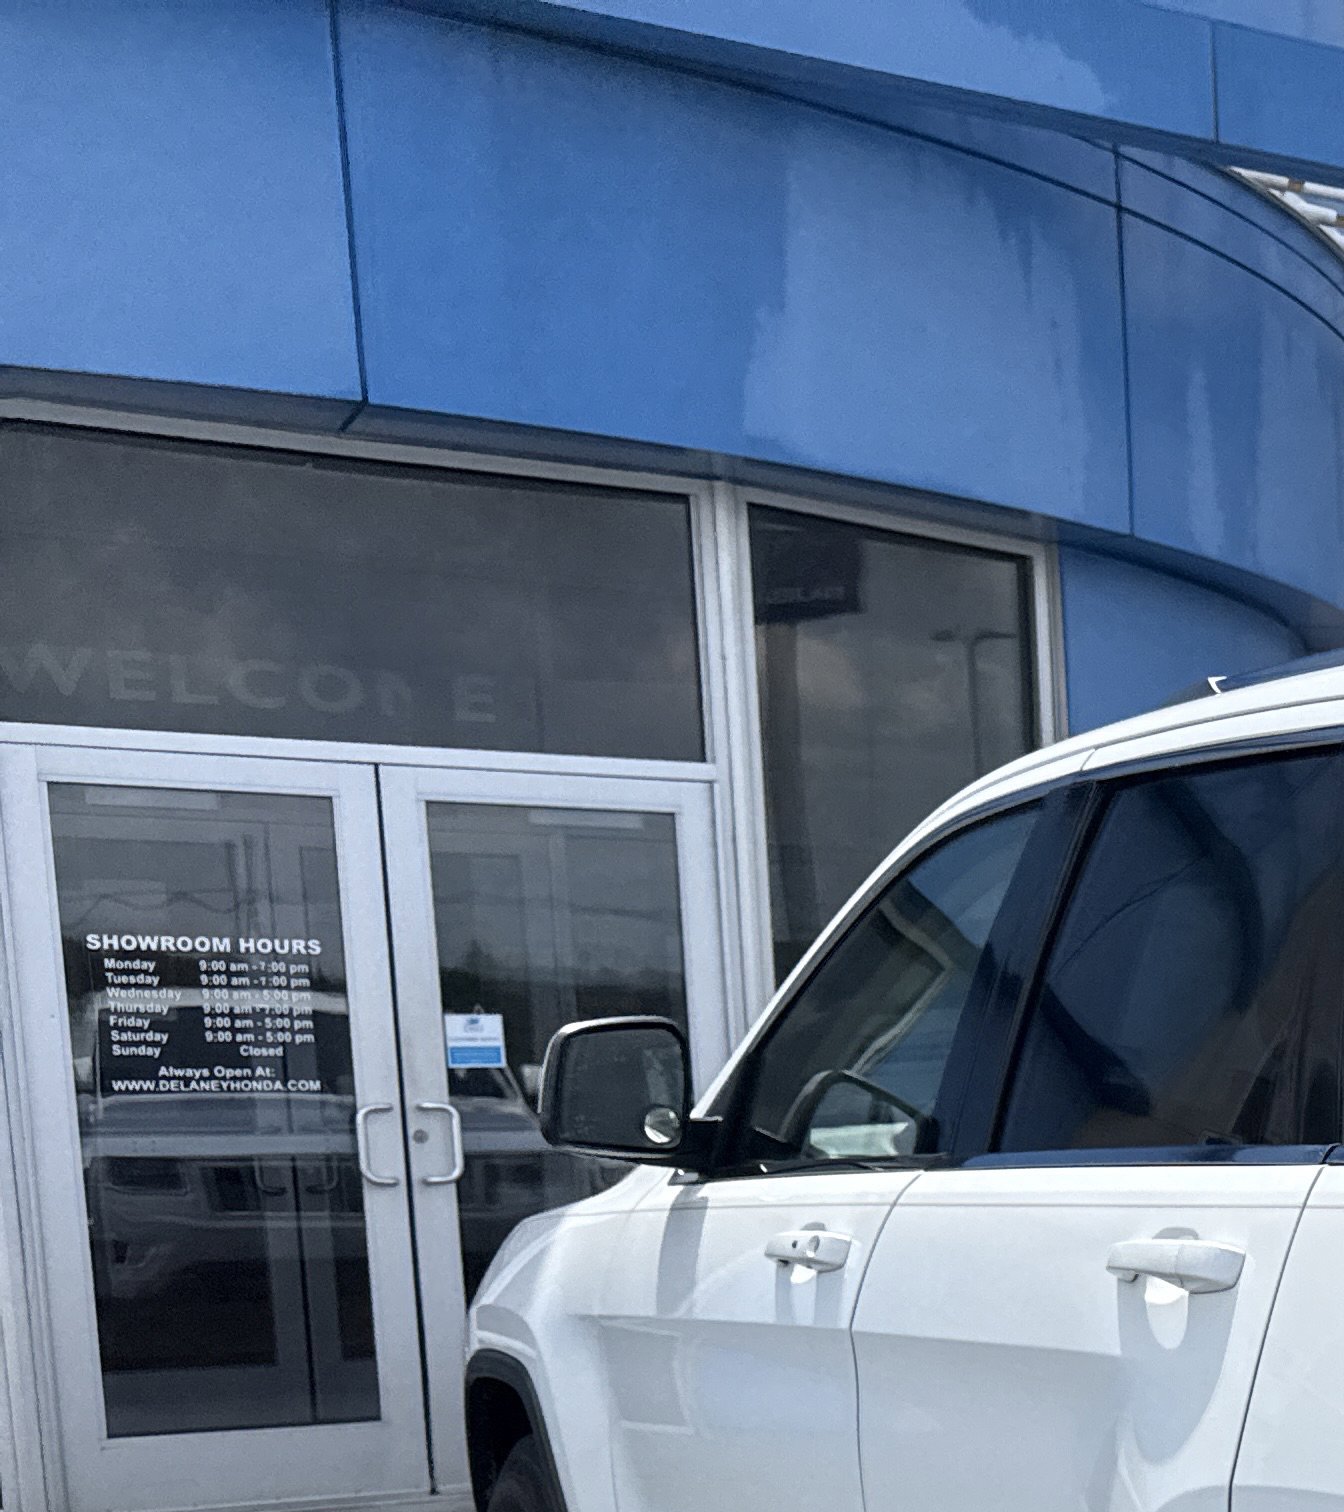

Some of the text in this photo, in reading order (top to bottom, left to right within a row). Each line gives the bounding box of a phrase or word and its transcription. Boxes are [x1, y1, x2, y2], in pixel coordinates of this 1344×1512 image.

[86, 933, 322, 955] SHOWROOM HOURS
[104, 958, 156, 973] Monday
[199, 960, 226, 972] 9:00
[229, 962, 249, 972] am
[289, 964, 310, 976] pm
[105, 972, 160, 987] Tuesday
[200, 974, 228, 986] 9:00
[230, 977, 251, 987] am
[290, 978, 311, 989] pm
[106, 987, 182, 1001] Wednesday
[202, 989, 229, 1000] 9:00
[232, 991, 251, 1001] am
[292, 992, 311, 1003] pm
[107, 1001, 169, 1016] Thursday
[203, 1003, 230, 1014] 9:00
[233, 1006, 253, 1015] am
[293, 1006, 313, 1018] pm
[109, 1016, 150, 1030] Friday
[204, 1017, 231, 1028] 9:00
[234, 1019, 254, 1029] am
[264, 1018, 291, 1029] 5:00
[293, 1020, 314, 1031] pm
[110, 1030, 169, 1045] Saturday
[205, 1031, 232, 1042] 9:00
[235, 1033, 255, 1043] am
[265, 1031, 292, 1043] 5:00
[294, 1034, 315, 1045] pm
[111, 1044, 284, 1059] Sunday Closed
[158, 1066, 276, 1079] Always Open At:
[111, 1080, 322, 1092] WWW.DELANEYHONDA.COM
